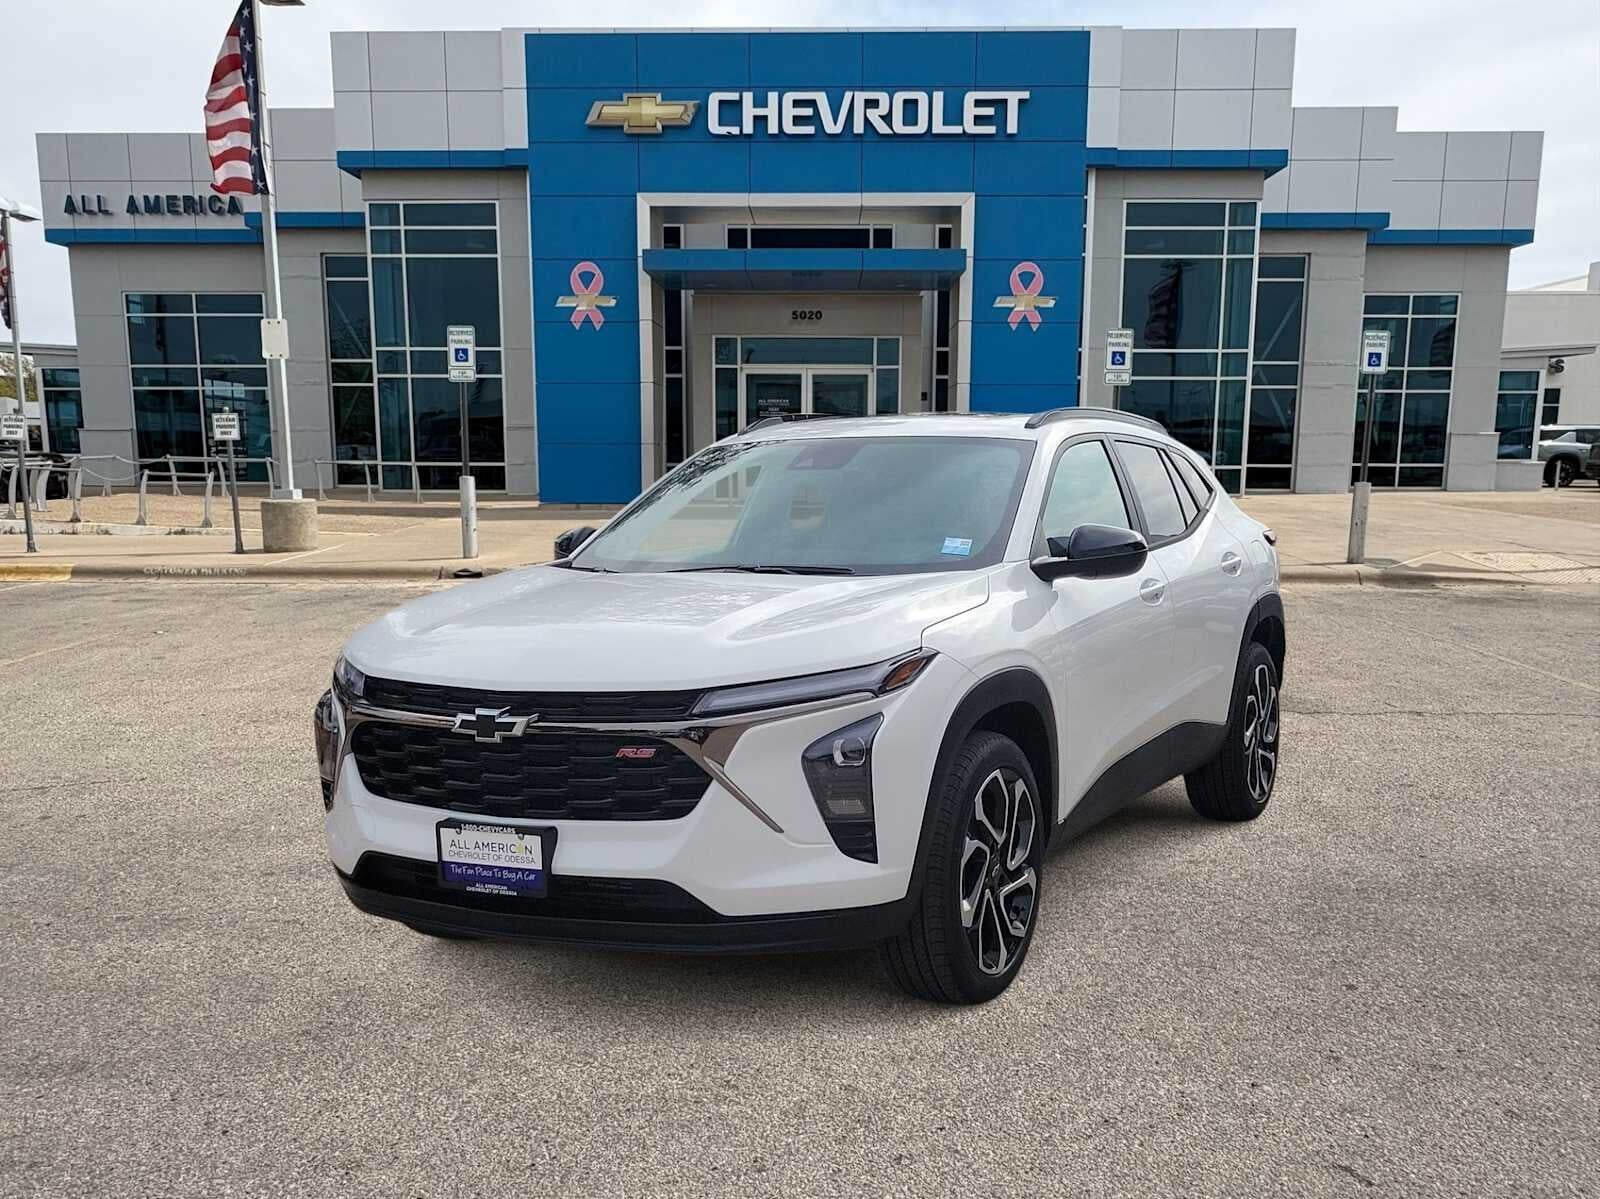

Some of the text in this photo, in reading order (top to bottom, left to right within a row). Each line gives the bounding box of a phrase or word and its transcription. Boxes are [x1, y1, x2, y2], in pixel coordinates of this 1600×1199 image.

[707, 91, 1030, 135] CHEVROLET
[64, 194, 243, 216] ALL AMERICA
[791, 310, 822, 320] 5020
[616, 748, 656, 758] RS
[450, 839, 470, 850] ALL
[448, 849, 536, 864] CHEVROLET OF ODESSA
[450, 864, 462, 874] The
[476, 867, 492, 877] Place
[493, 869, 501, 878] To
[503, 870, 516, 881] Buy
[516, 872, 523, 880] A
[524, 872, 536, 881] Car
